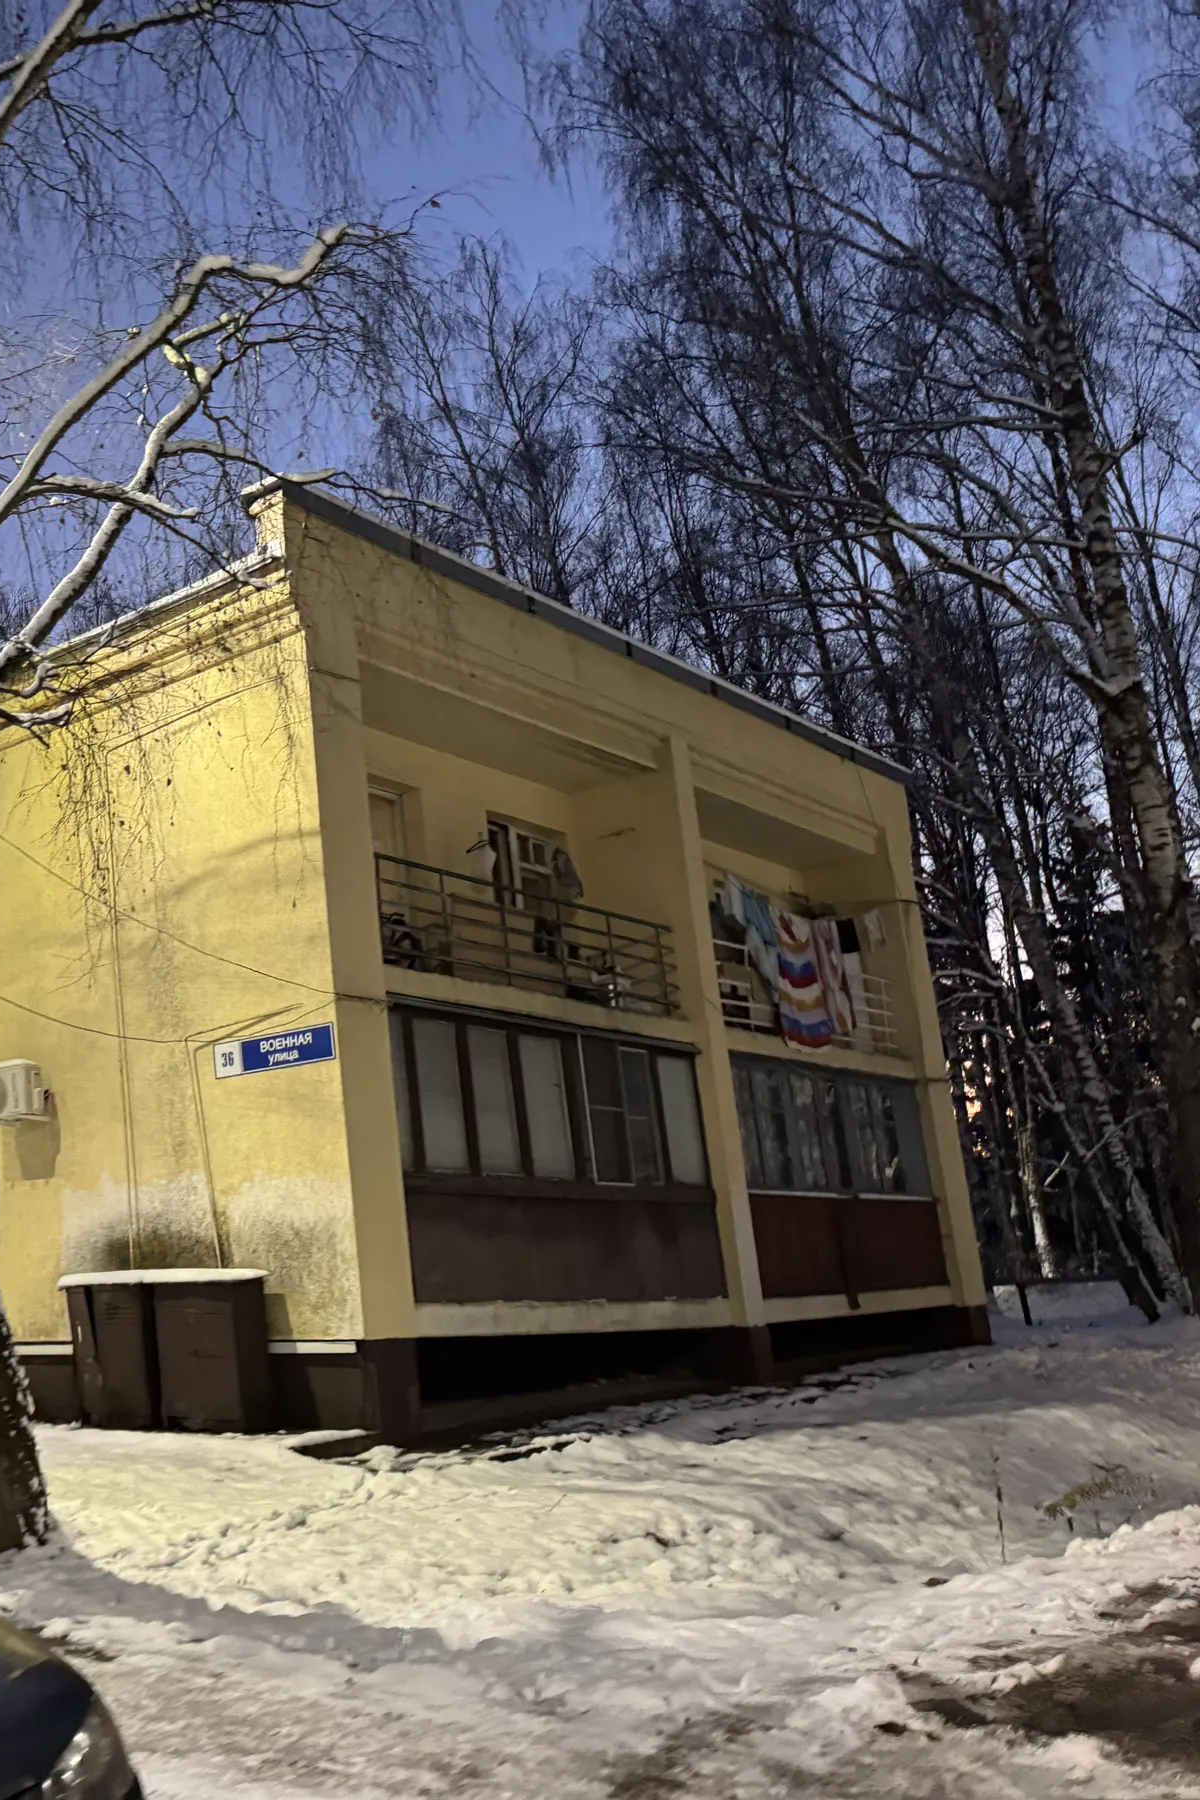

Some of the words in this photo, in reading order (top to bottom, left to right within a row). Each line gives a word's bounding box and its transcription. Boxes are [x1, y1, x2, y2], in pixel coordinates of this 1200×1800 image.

[260, 1032, 313, 1053] ВОЕННАЯ
[221, 1052, 235, 1068] 36
[268, 1049, 300, 1066] улица
